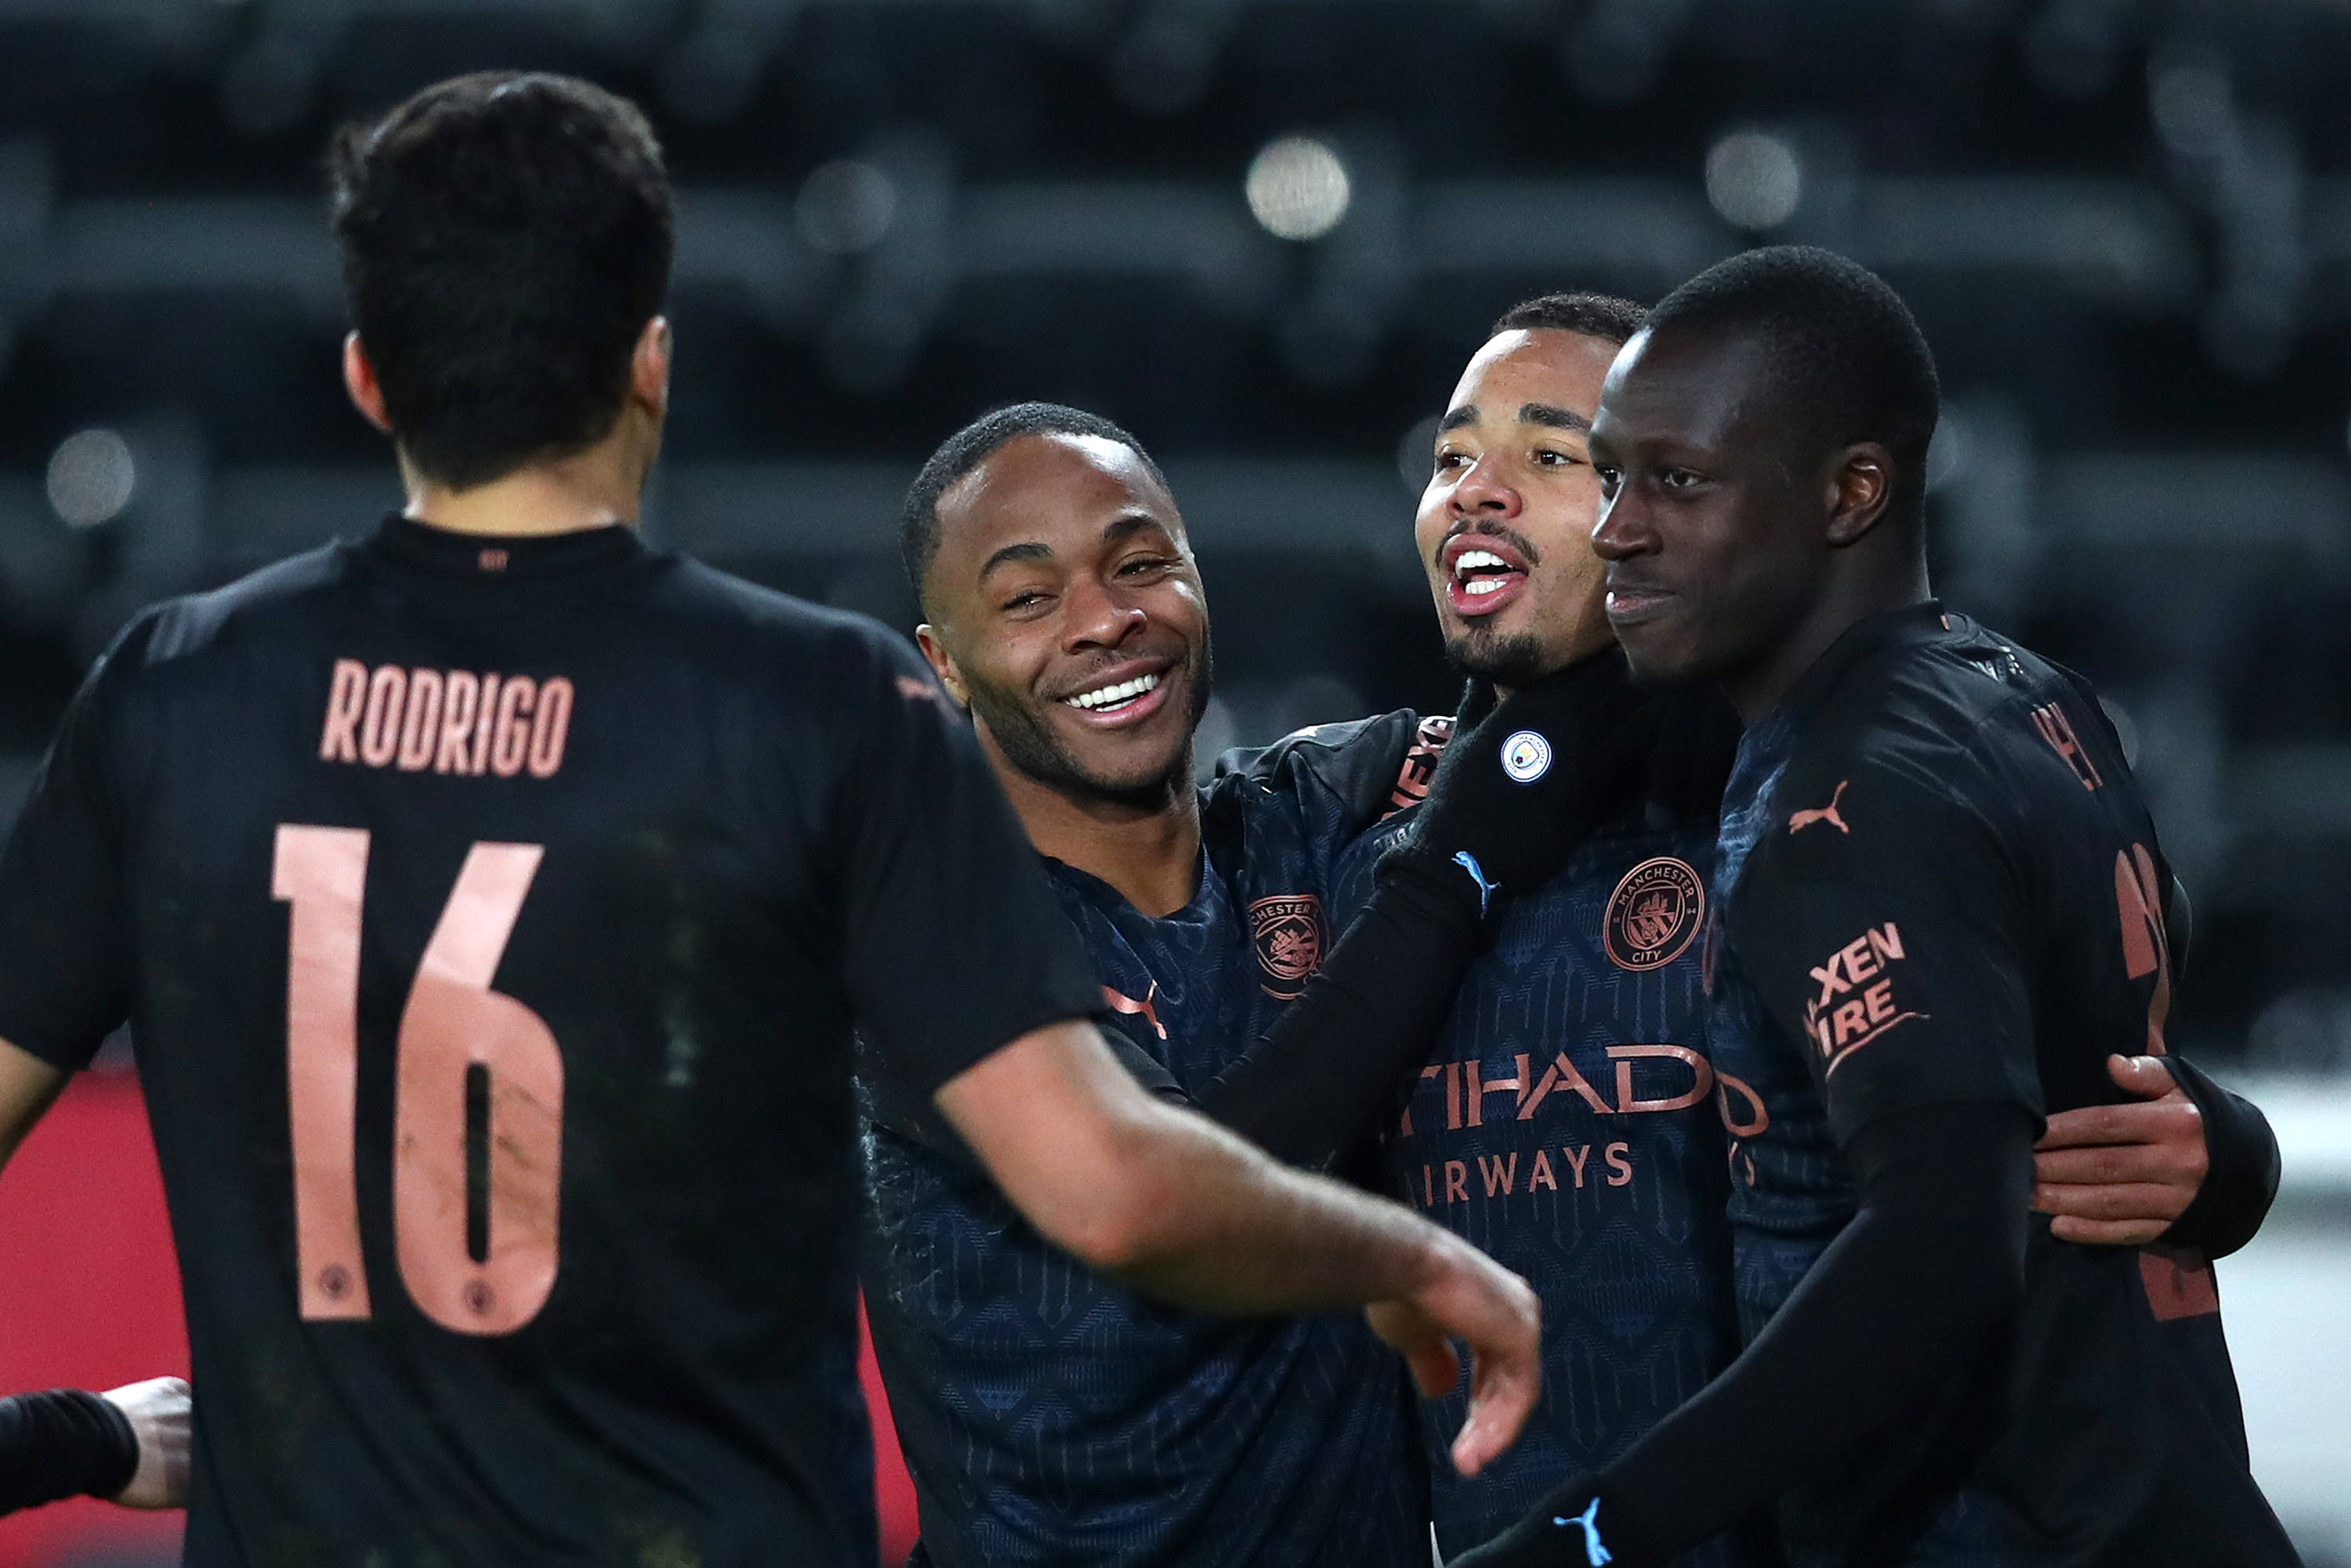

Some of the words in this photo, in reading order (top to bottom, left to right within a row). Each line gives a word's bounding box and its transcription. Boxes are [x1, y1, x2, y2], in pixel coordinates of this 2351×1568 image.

[320, 657, 574, 778] RODRIGO
[1251, 904, 1311, 925] CHESTER
[1618, 867, 1695, 906] MANCHESTER
[1632, 950, 1661, 963] CITY
[1809, 922, 1905, 1009] XEN
[1804, 977, 1896, 1057] IRE
[271, 823, 563, 1335] 16
[1423, 1142, 1632, 1207] IRWAYS
